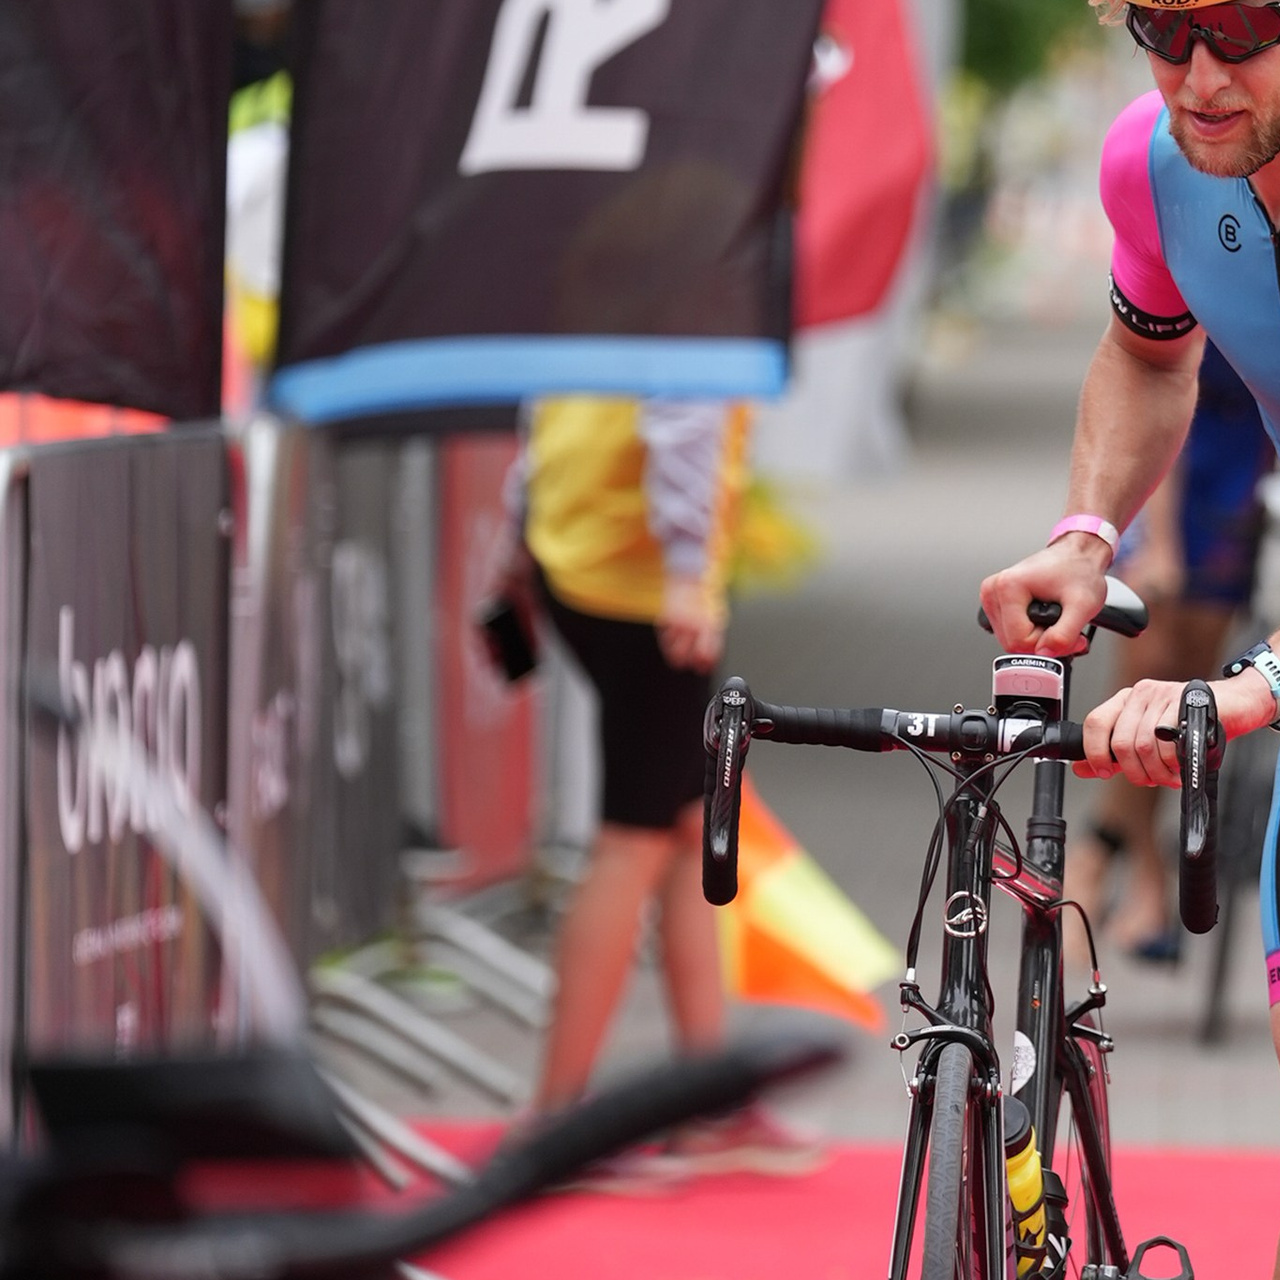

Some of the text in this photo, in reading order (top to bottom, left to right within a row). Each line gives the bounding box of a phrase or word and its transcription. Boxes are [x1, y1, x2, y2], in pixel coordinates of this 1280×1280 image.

[1011, 658, 1046, 668] GARMIN
[907, 713, 940, 737] 3T
[723, 728, 735, 788] RECORD
[1192, 730, 1200, 789] RECORD
